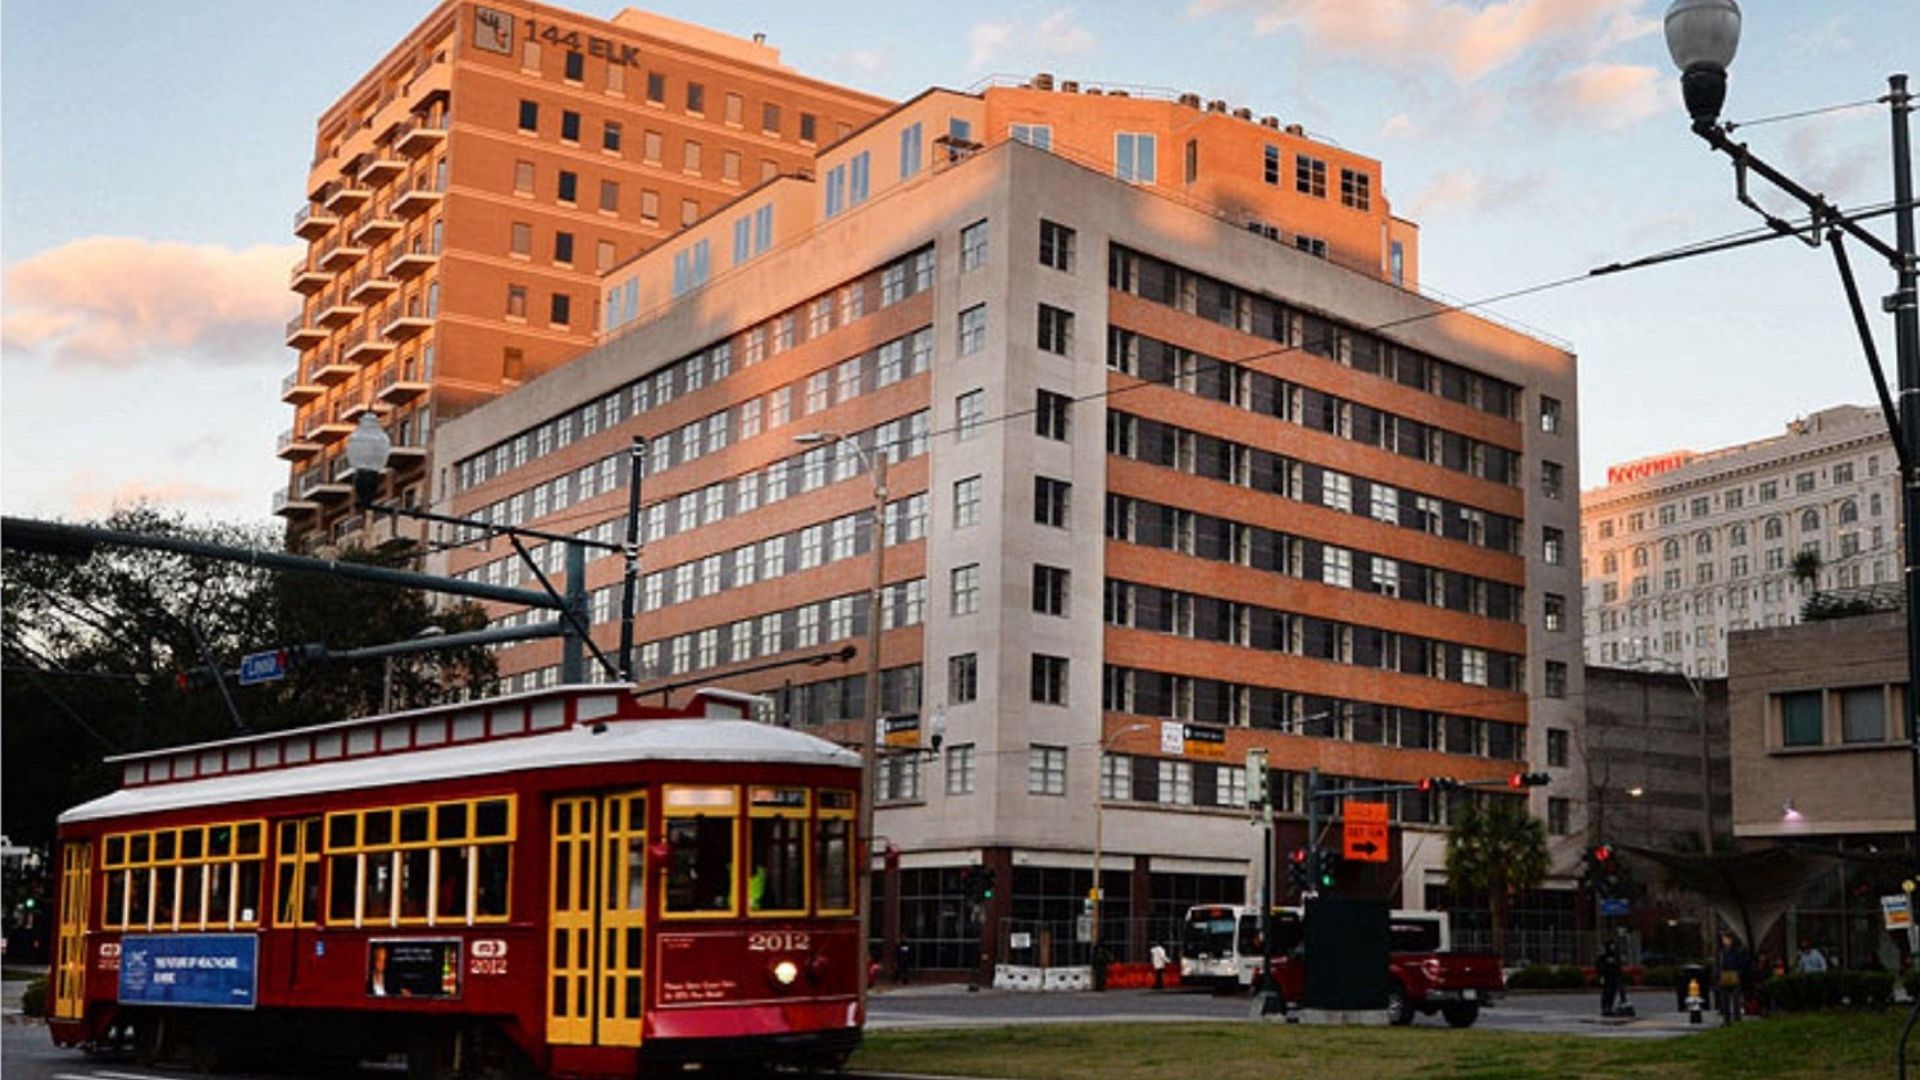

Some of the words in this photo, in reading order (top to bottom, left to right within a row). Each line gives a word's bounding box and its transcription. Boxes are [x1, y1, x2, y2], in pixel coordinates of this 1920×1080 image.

[524, 19, 580, 50] 144
[588, 35, 641, 68] ELK
[748, 931, 811, 951] 2012
[470, 959, 507, 975] 2012
